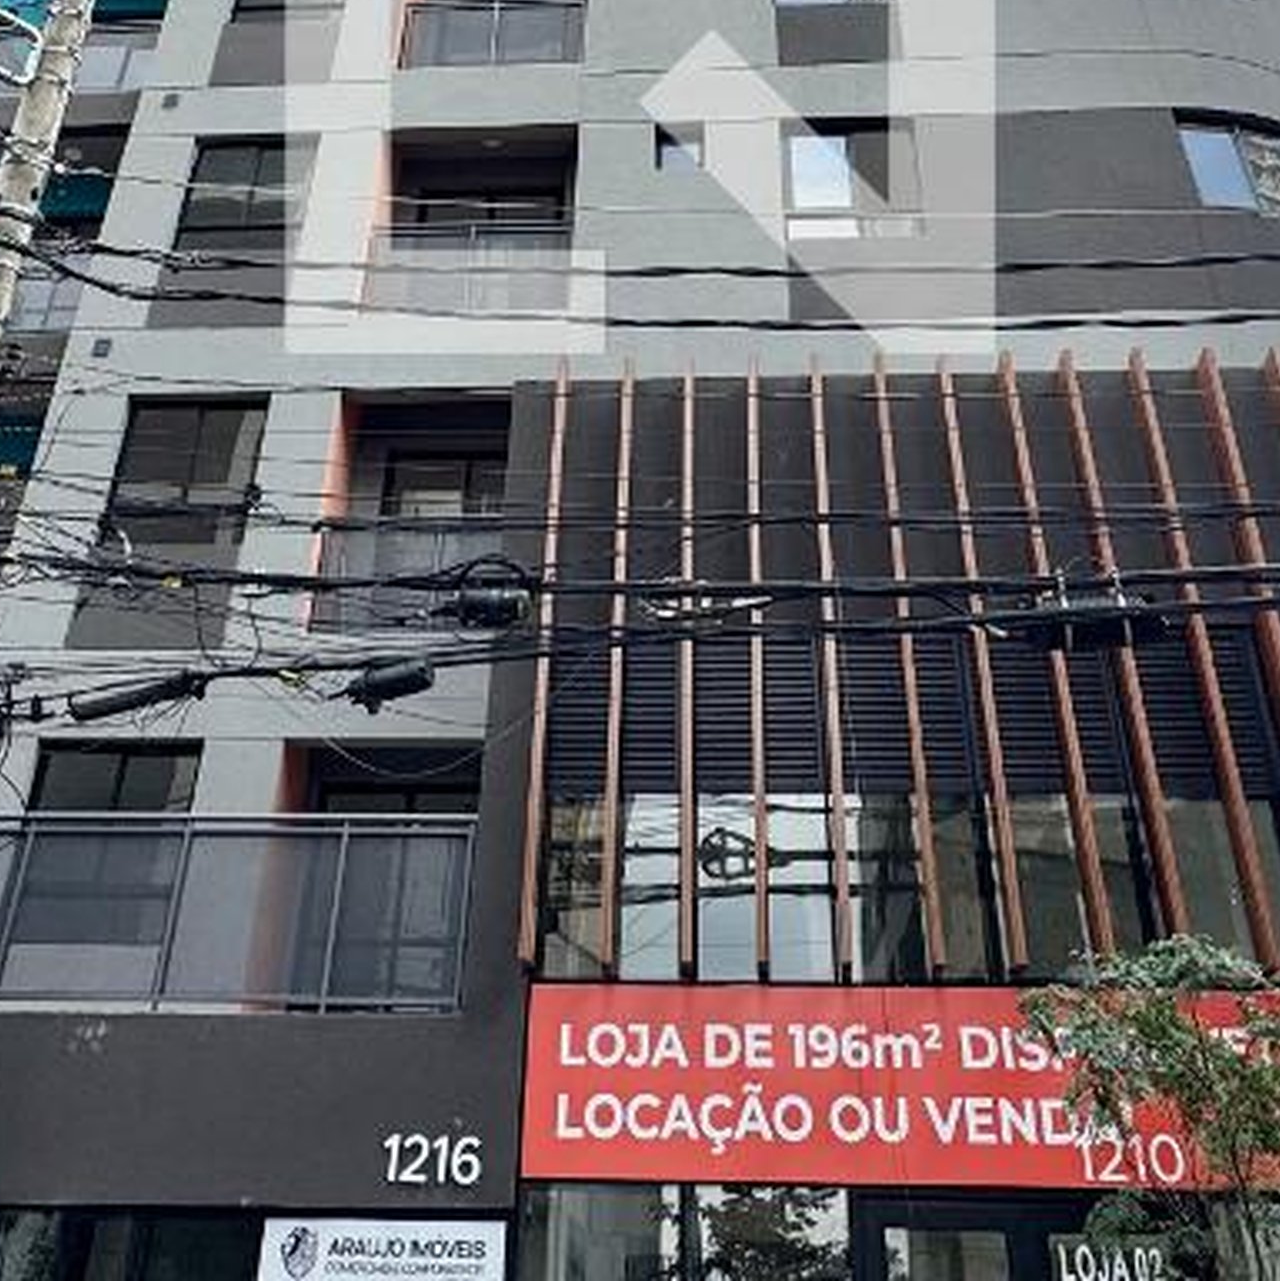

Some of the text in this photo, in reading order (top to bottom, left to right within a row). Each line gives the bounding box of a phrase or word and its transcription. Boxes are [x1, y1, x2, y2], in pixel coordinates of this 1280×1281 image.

[559, 1023, 689, 1068] LOJA
[704, 1023, 775, 1069] DE
[556, 1082, 1133, 1154] LOCAÇÃO OU VEND
[383, 1133, 482, 1186] 1216
[1076, 1132, 1185, 1183] 1210
[1057, 1243, 1130, 1281] LOJA
